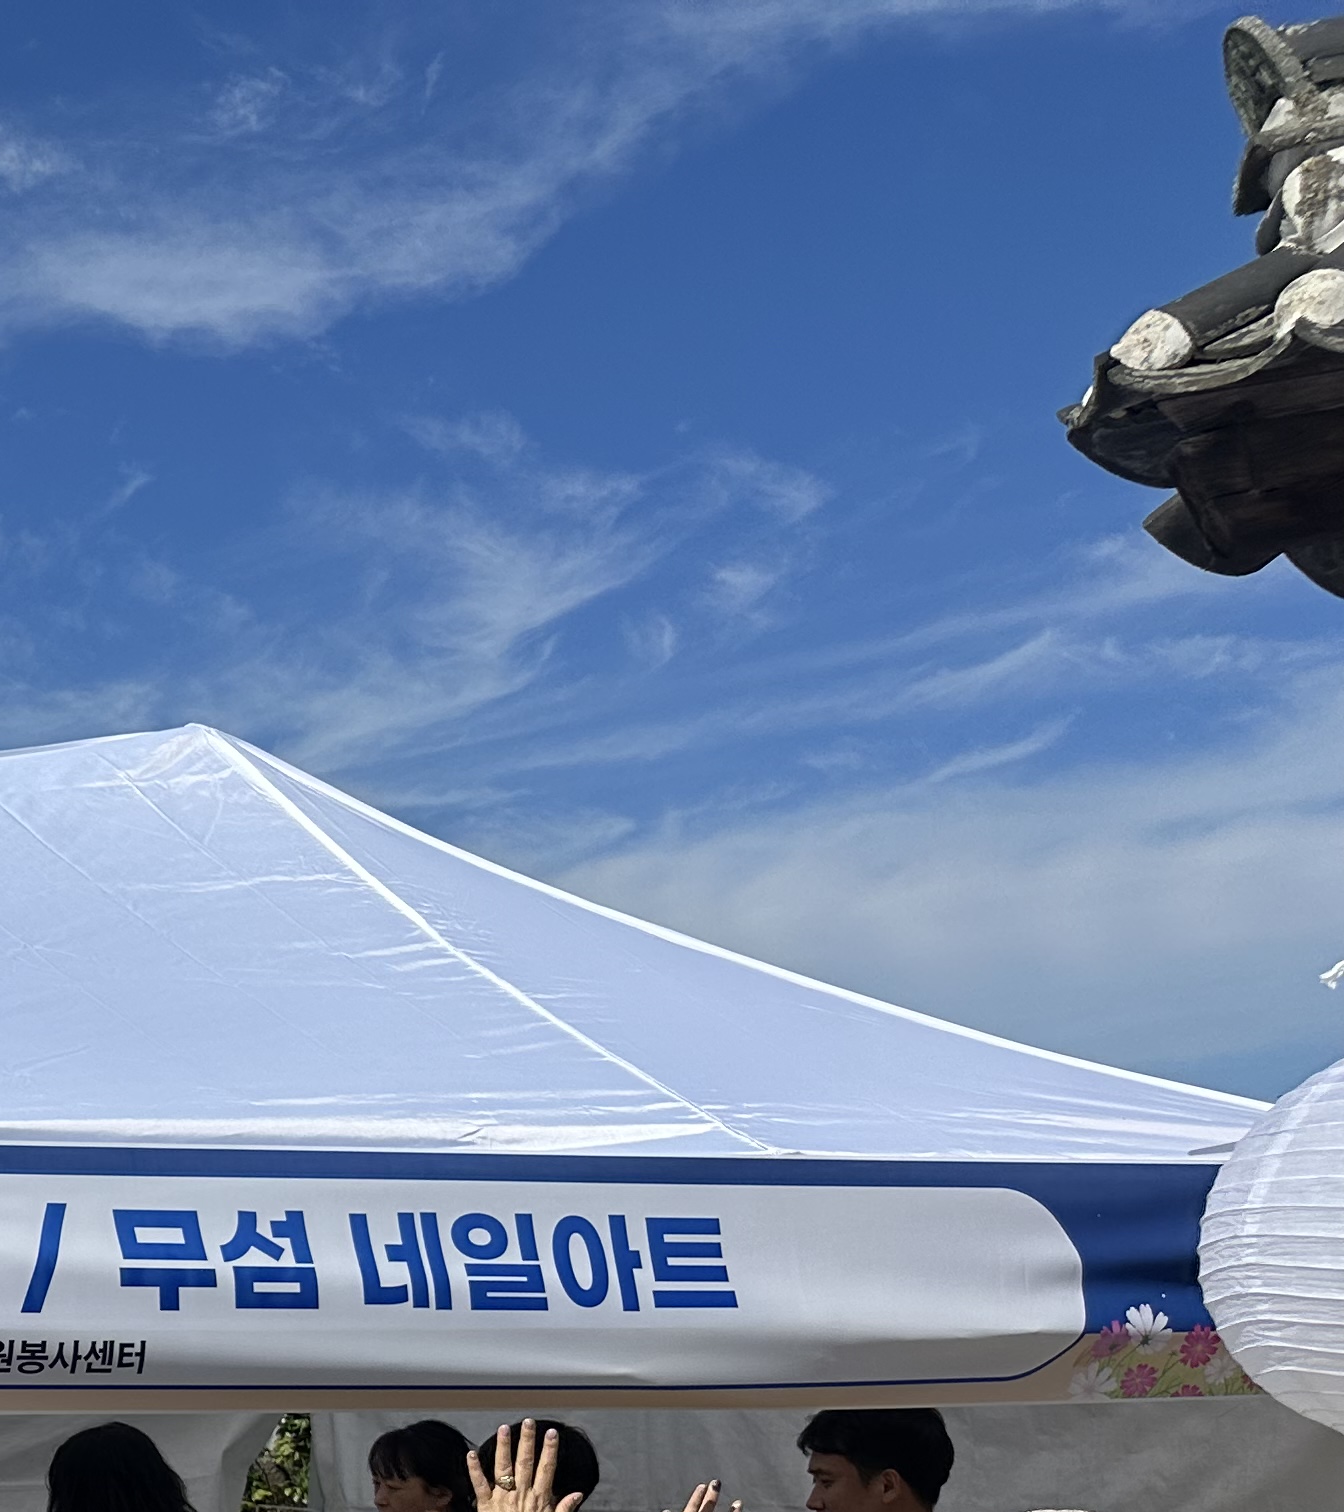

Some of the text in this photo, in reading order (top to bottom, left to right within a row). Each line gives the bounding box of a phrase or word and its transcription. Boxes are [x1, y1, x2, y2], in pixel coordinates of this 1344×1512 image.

[20, 1202, 67, 1313] /
[111, 1208, 320, 1311] 무섬
[348, 1211, 739, 1312] 네일아트
